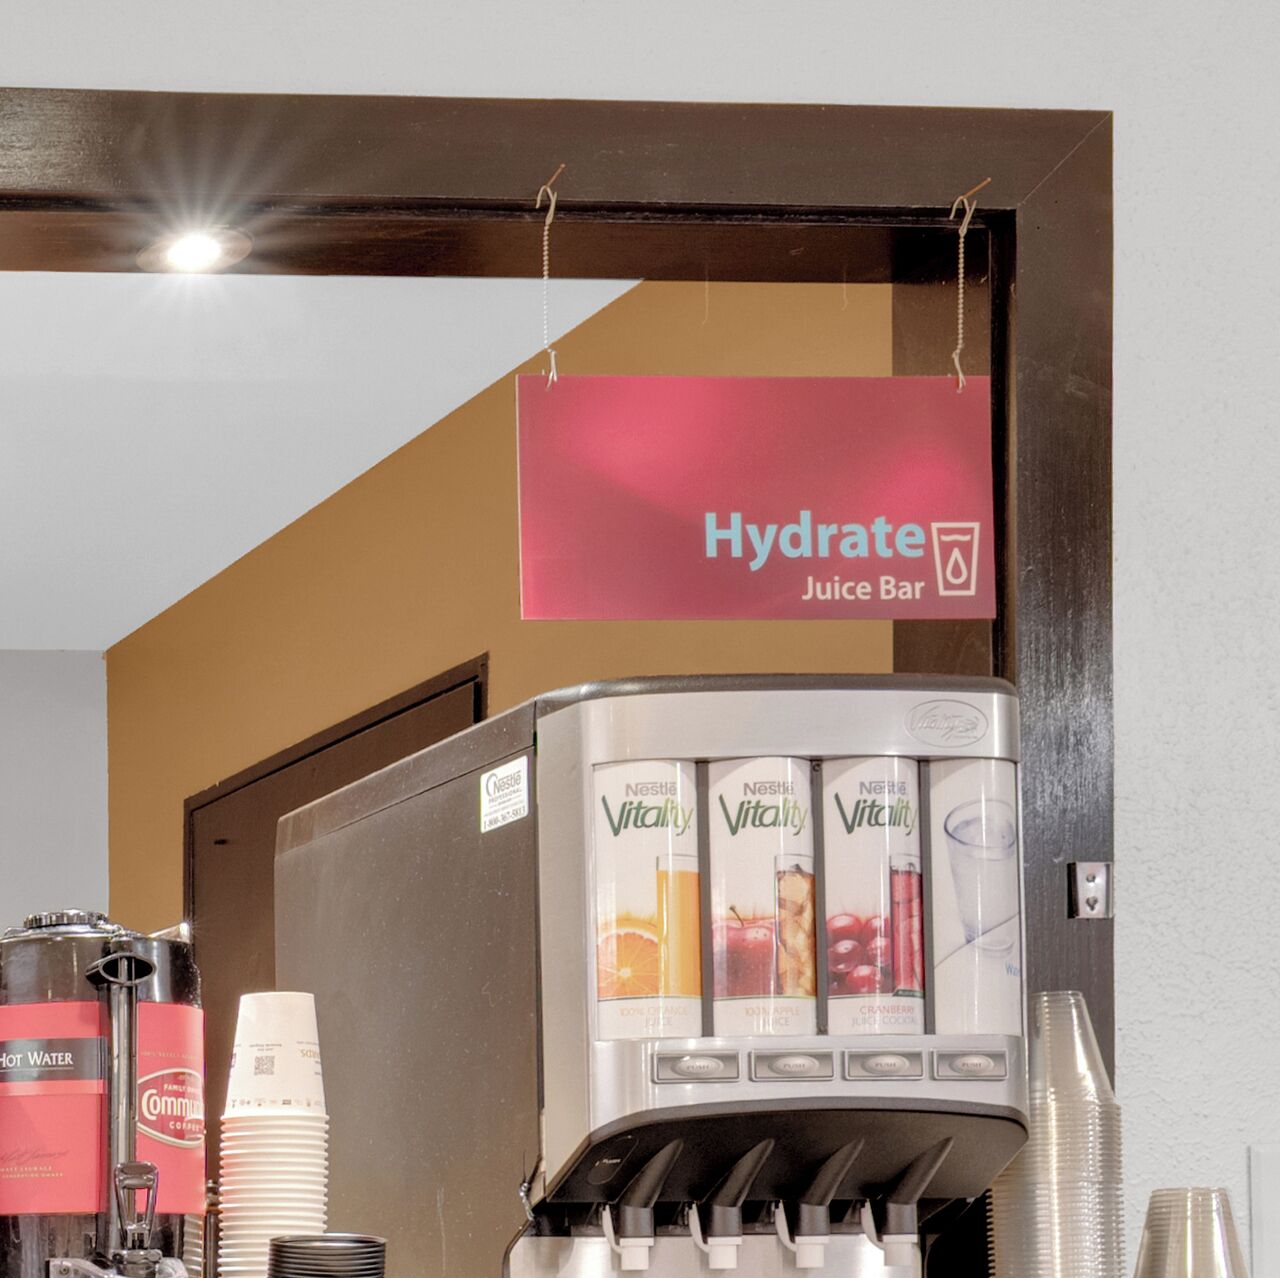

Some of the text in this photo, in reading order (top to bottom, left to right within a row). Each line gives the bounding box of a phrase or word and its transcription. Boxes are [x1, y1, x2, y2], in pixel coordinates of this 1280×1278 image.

[705, 510, 925, 572] Hydrate
[801, 575, 925, 601] Juice Bar
[602, 795, 694, 836] Vitality
[719, 794, 808, 836] Vitality
[834, 792, 918, 836] Vitality
[27, 1051, 74, 1066] WATER
